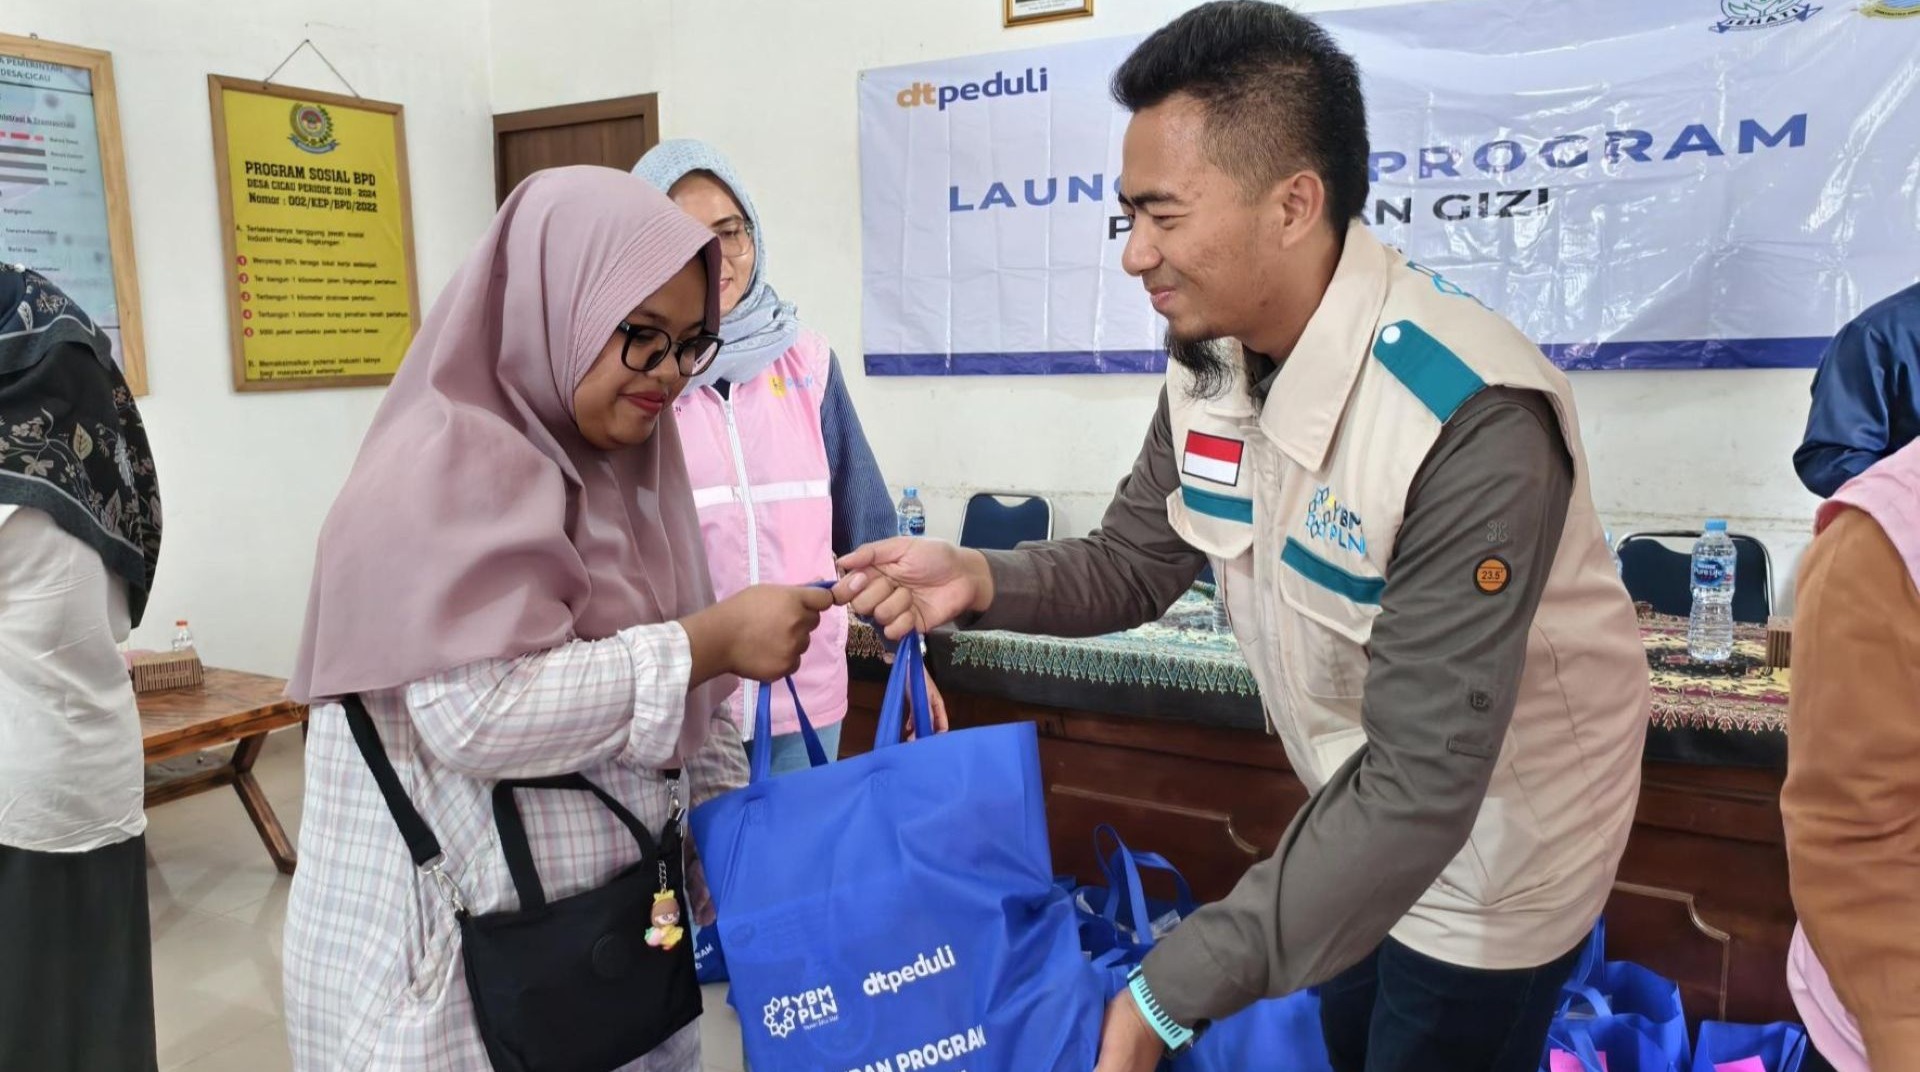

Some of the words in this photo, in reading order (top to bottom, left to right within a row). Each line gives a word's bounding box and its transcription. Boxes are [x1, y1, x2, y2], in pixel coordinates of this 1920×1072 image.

[1, 68, 22, 79] DESA
[896, 67, 1048, 111] dtpeduli
[245, 161, 306, 179] PROGRAM
[309, 167, 350, 184] SOSIAL
[353, 172, 376, 187] BPD
[247, 178, 270, 189] DESA
[271, 180, 296, 191] CICAU
[298, 182, 332, 195] PERIODE
[358, 188, 377, 199] 2024
[249, 192, 280, 205] Nomor
[288, 195, 378, 213] 002/KEP/BPD/2022
[1432, 187, 1549, 221] GIZI
[1329, 523, 1366, 554] PLN
[863, 944, 957, 997] dtpeduli
[791, 985, 834, 1009] YBM
[797, 998, 839, 1025] PLN
